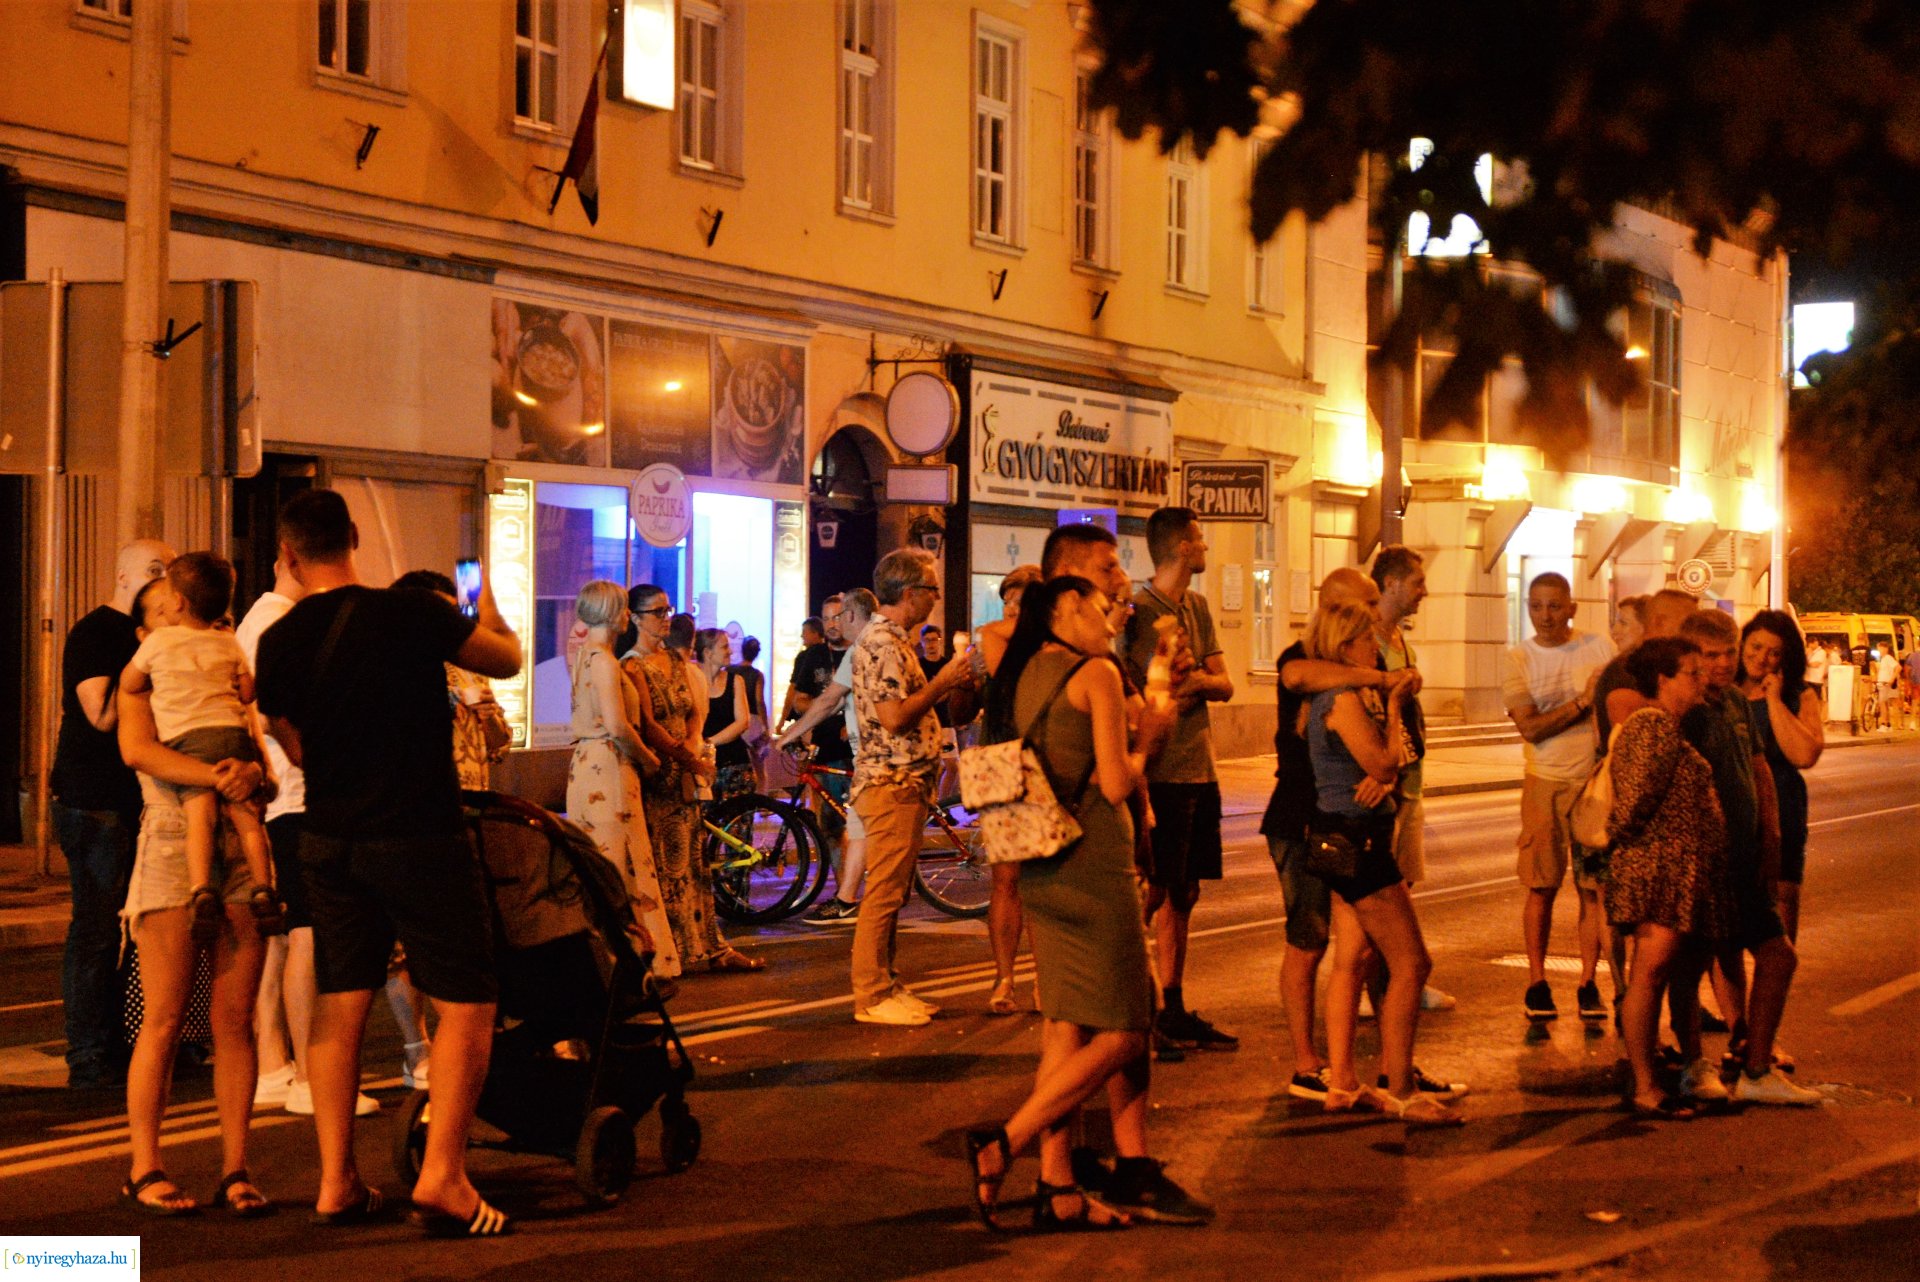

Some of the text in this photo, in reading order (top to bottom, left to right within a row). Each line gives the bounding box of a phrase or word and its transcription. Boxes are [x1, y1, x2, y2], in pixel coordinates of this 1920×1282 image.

[998, 431, 1169, 495] GYÓGYSZERTÁR
[638, 494, 686, 519] PAPRIKA
[1203, 487, 1263, 513] PATIKA
